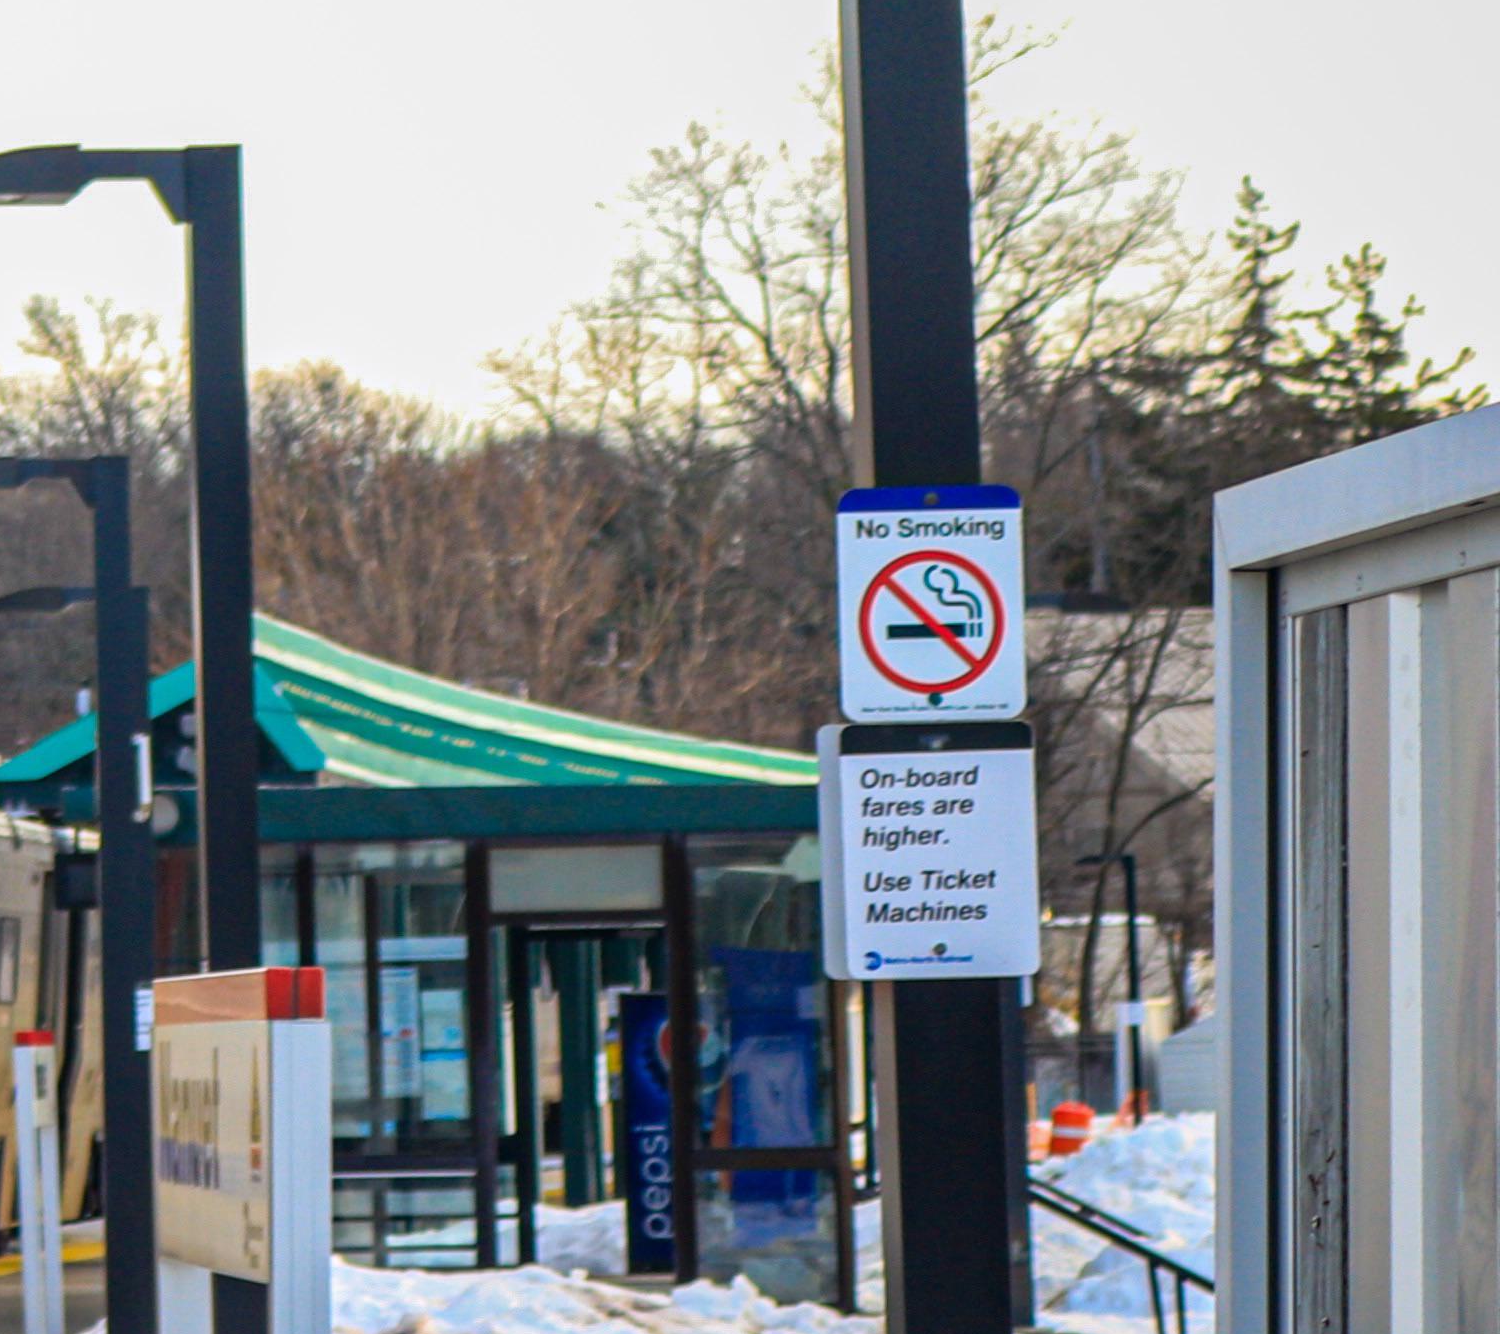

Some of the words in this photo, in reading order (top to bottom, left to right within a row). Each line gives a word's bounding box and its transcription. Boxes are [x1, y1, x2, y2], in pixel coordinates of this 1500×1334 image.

[856, 519, 890, 539] No
[897, 516, 1006, 540] Smoking
[860, 765, 980, 790] On-board
[861, 797, 925, 817] fares
[932, 798, 975, 815] are
[862, 826, 950, 852] higher.
[863, 871, 912, 892] Use
[920, 869, 997, 890] Ticket
[866, 901, 989, 924] Machines
[633, 1121, 674, 1240] pepsi
